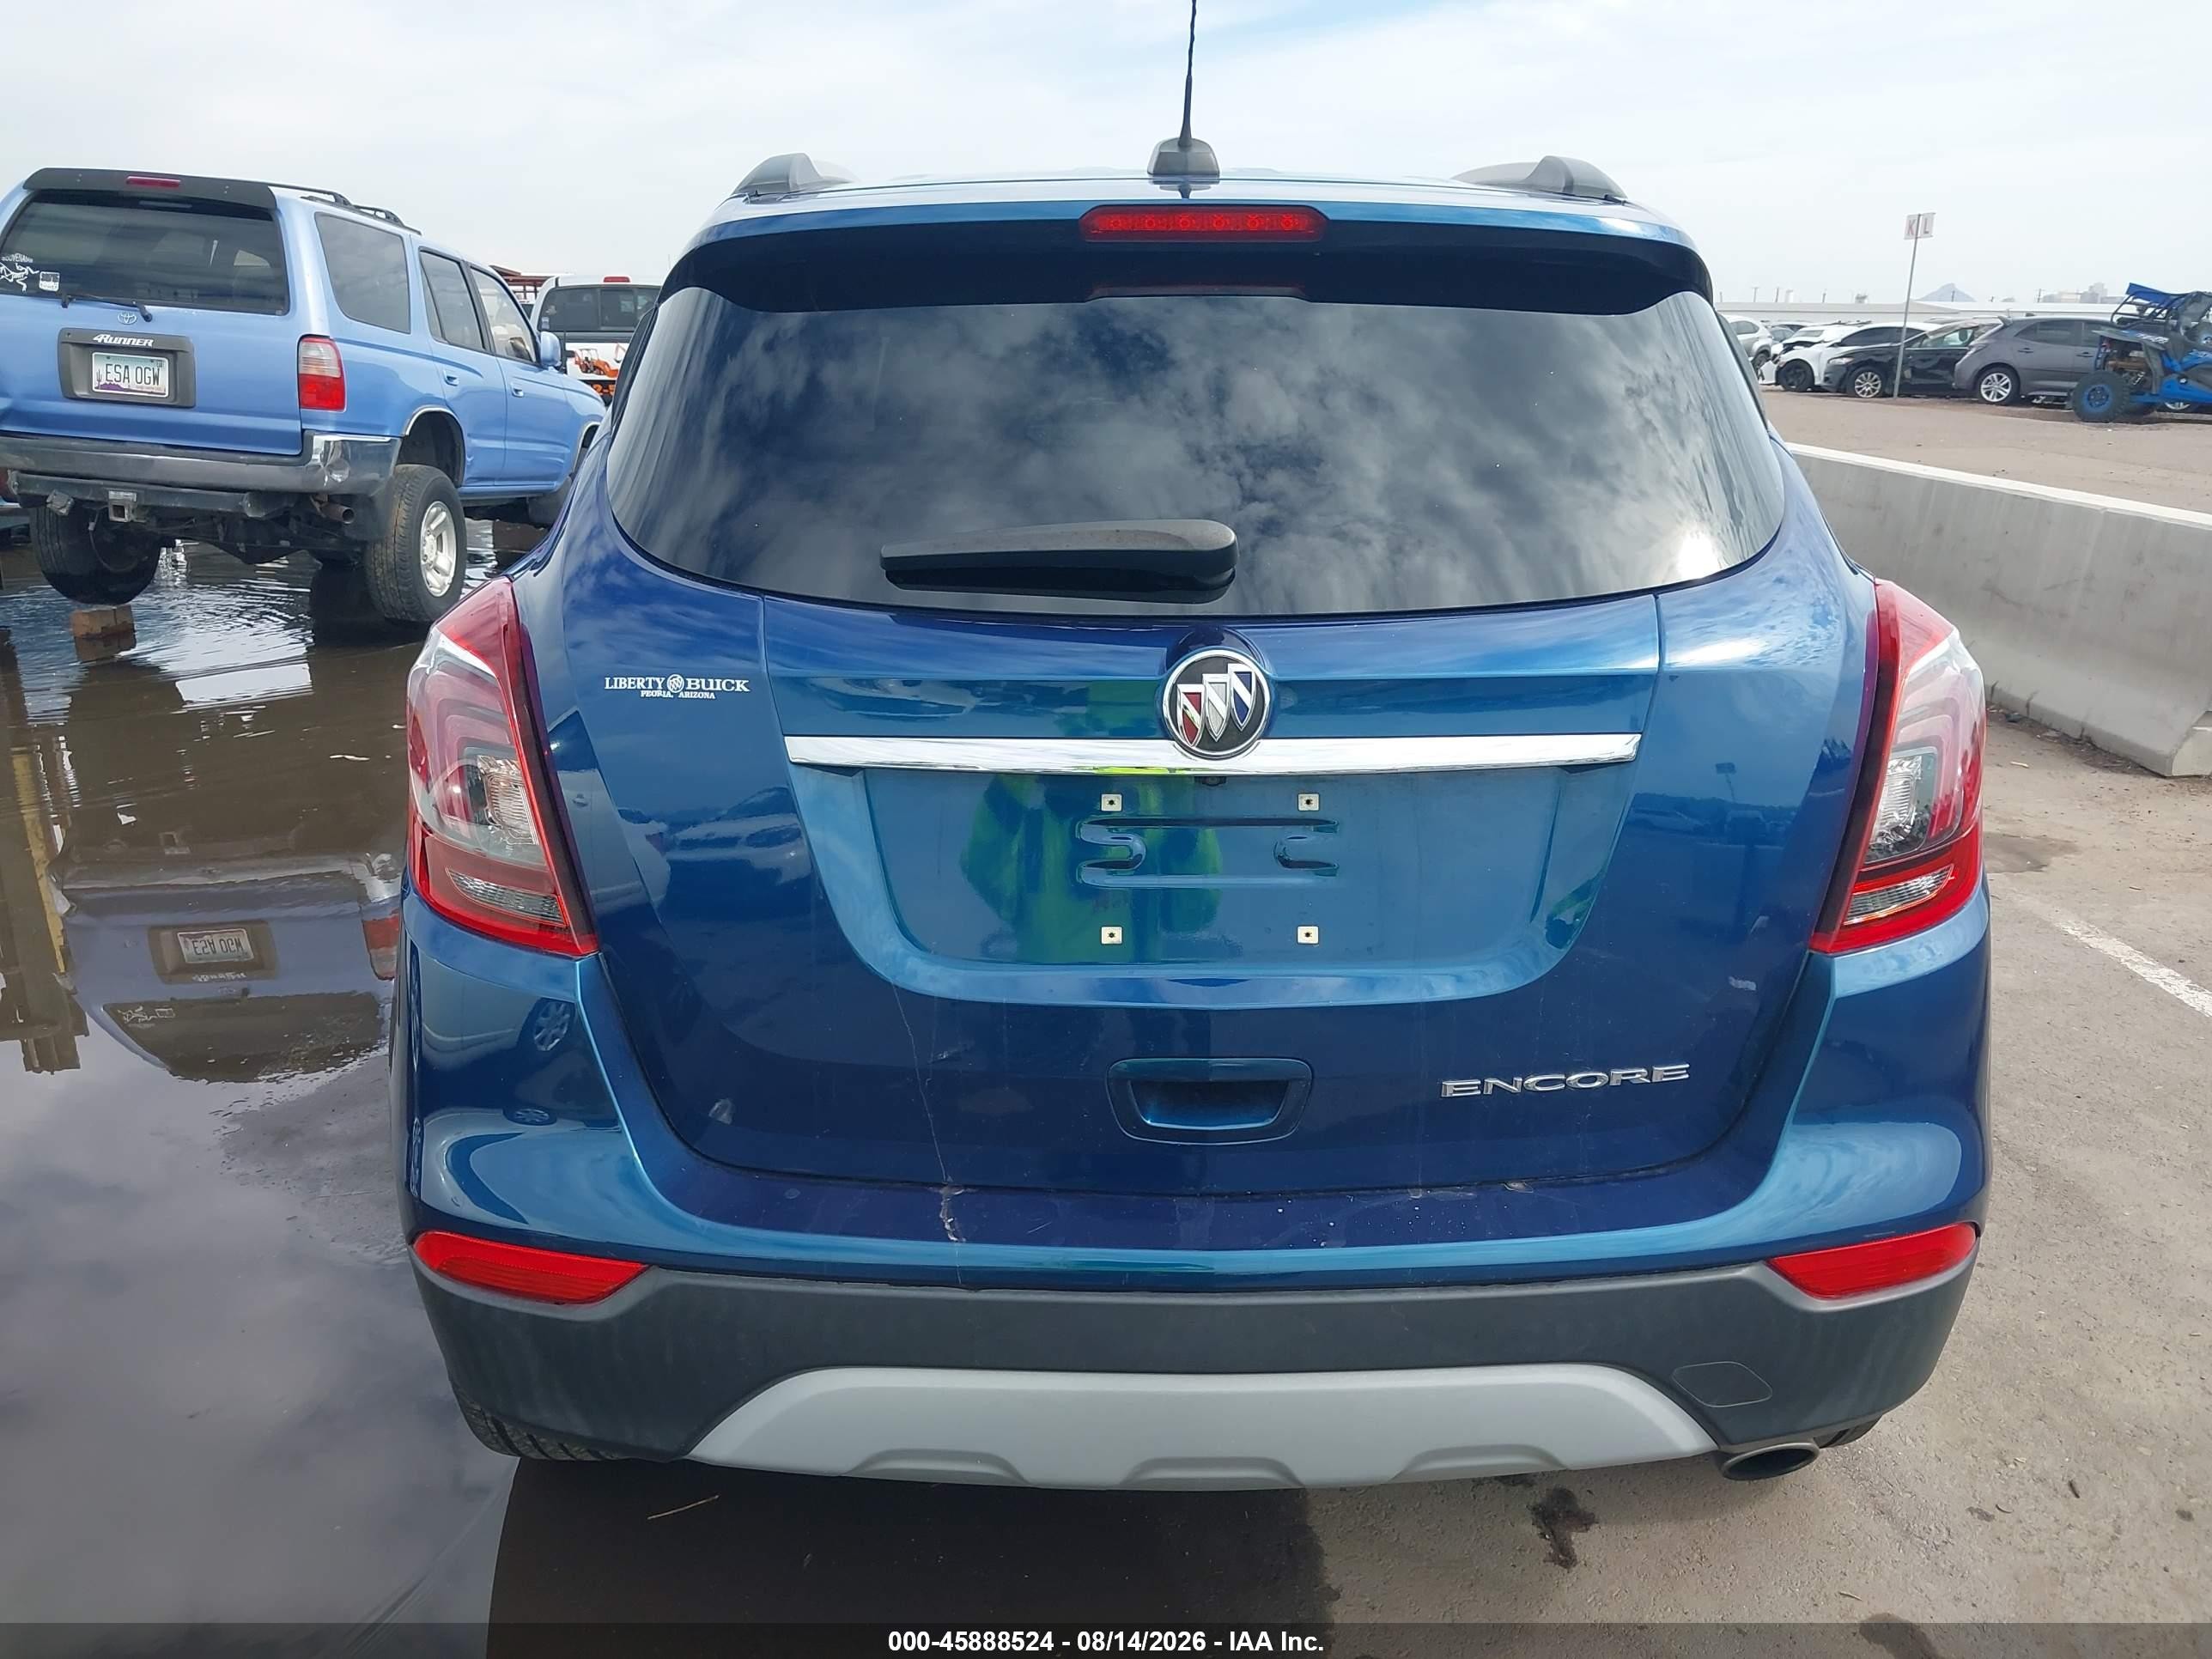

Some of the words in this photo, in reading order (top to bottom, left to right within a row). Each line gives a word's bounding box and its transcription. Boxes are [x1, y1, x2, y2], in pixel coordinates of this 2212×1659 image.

[1906, 218, 1917, 235] K
[1923, 217, 1930, 234] L
[93, 334, 155, 347] 4RUNNER
[105, 363, 131, 384] ESA
[604, 677, 665, 690] LIBERTY
[686, 678, 750, 692] BUICK
[678, 690, 716, 700] ARIZONA
[1441, 1063, 1691, 1098] ENCORE
